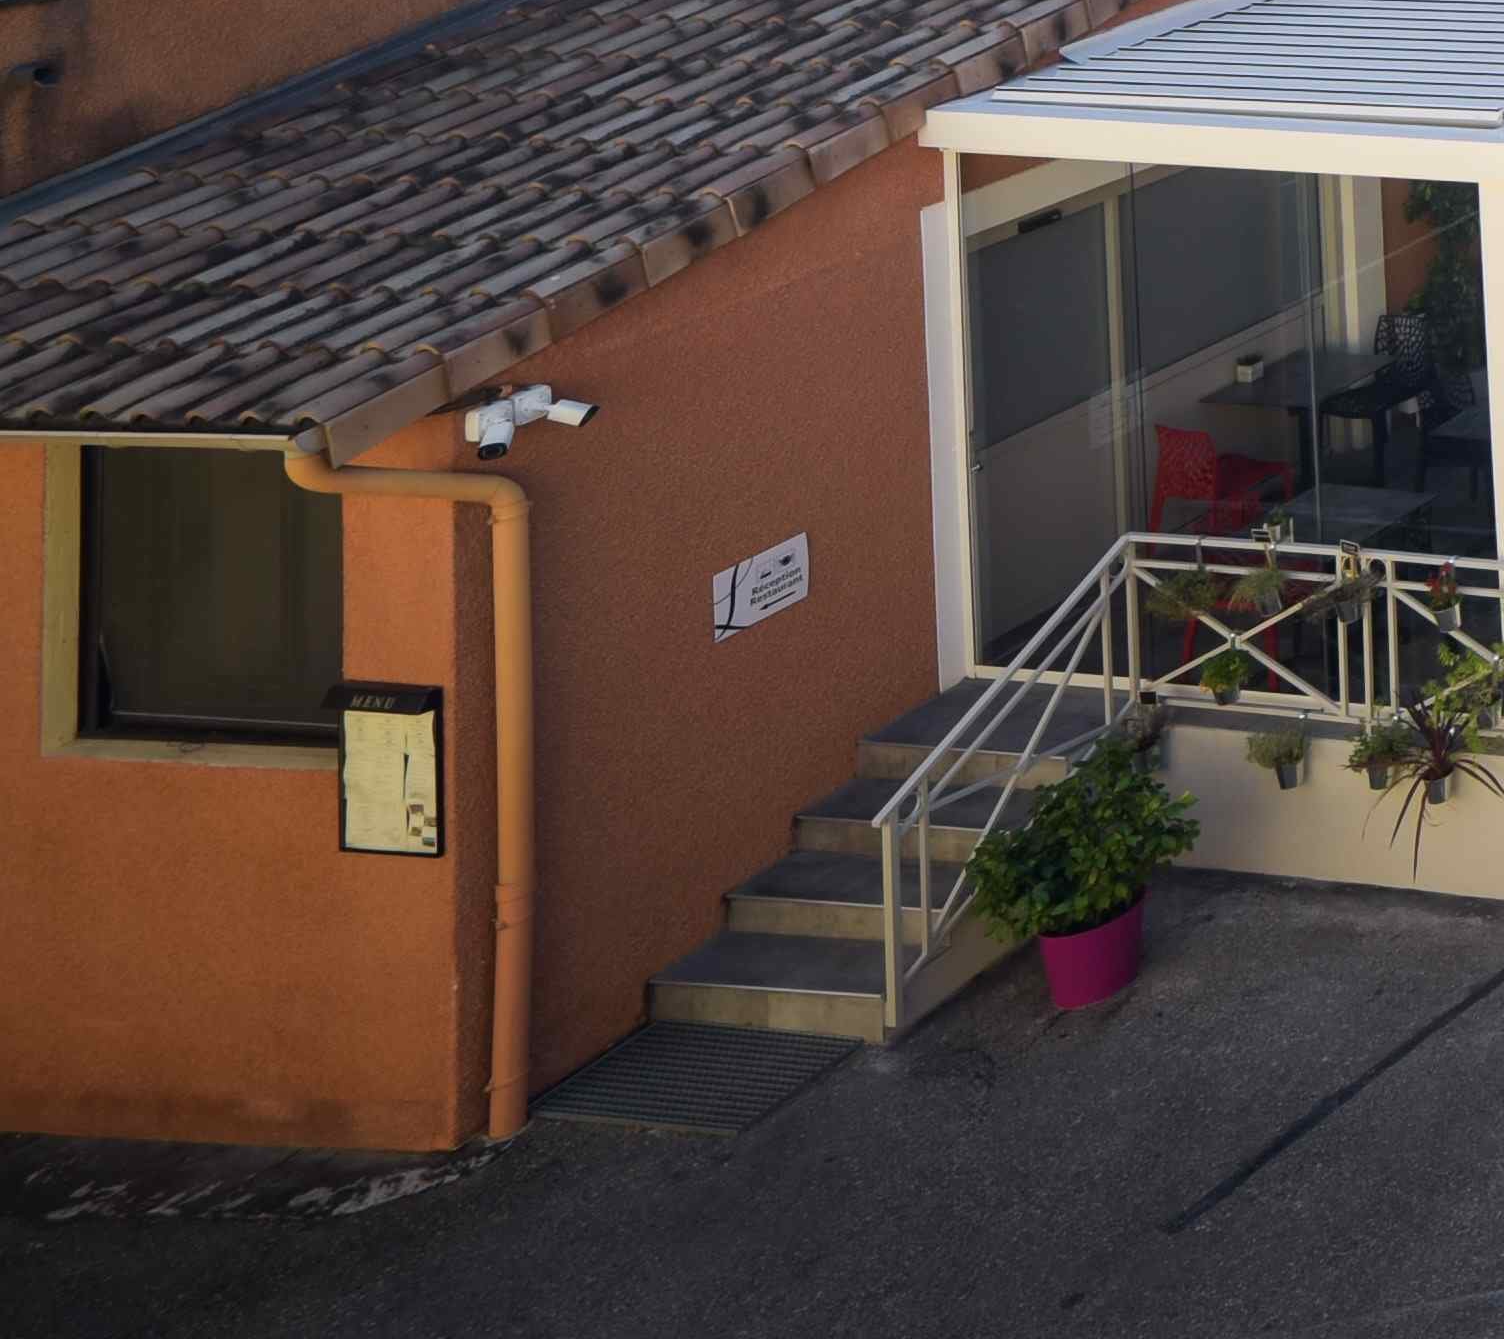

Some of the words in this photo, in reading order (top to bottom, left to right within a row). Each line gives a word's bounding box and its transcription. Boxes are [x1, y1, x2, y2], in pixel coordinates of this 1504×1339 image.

[750, 574, 803, 605] Restaurant
[752, 566, 801, 596] Réception
[350, 694, 396, 709] MENU
